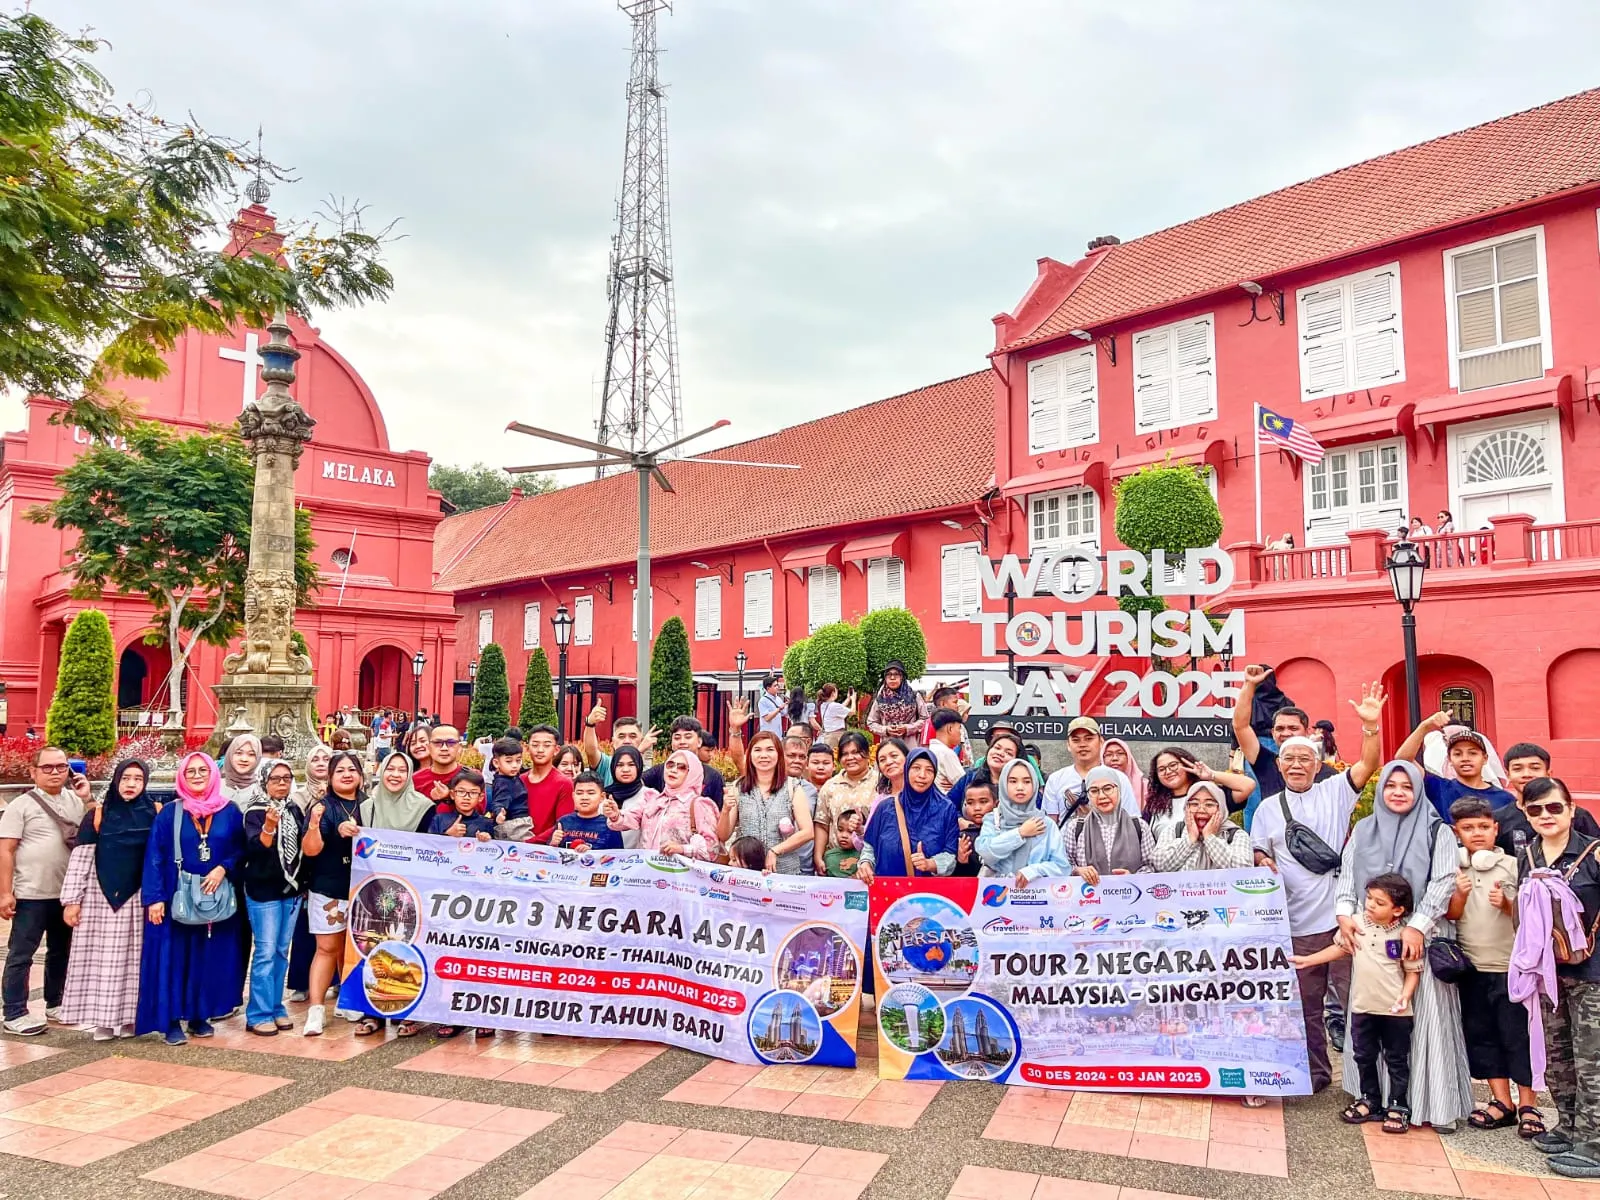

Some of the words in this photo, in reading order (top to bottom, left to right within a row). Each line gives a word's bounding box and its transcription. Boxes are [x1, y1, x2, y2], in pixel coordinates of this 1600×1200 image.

[322, 461, 396, 487] MELAKA
[976, 548, 1234, 603] WORLD
[969, 609, 1246, 657] TOURISM
[969, 670, 1095, 717] DAY
[1104, 670, 1246, 718] 2025
[1010, 722, 1063, 734] OSTED
[1162, 724, 1231, 737] MALAYSI
[418, 855, 450, 866] MALAYSIA
[1181, 889, 1206, 897] Trivat
[1209, 888, 1228, 896] Tour
[1236, 878, 1265, 886] SEGARA
[430, 894, 517, 925] TOUR
[528, 902, 544, 926] 3
[554, 904, 683, 940] NEGARA
[693, 920, 766, 954] ASIA
[426, 932, 500, 950] MALAYSIA
[515, 940, 607, 960] SINGAPORE
[622, 948, 692, 969] THAILAND
[695, 960, 763, 985] (HATYAI)
[990, 952, 1067, 976] TOUR
[1074, 953, 1089, 975] 2
[1097, 949, 1216, 975] NEGARA
[1222, 947, 1290, 971] ASIA
[443, 962, 461, 975] 30
[467, 964, 552, 983] DESEMBER
[558, 973, 597, 987] 2024
[611, 977, 631, 989] 05
[636, 978, 699, 999] JANUARI
[703, 991, 737, 1009] 2025
[1011, 985, 1126, 1005] MALAYSIA
[1149, 980, 1290, 1003] SINGAPORE
[451, 992, 509, 1016] EDISI
[514, 998, 583, 1022] LIBUR
[589, 1005, 668, 1028] TAHUN
[672, 1013, 725, 1043] BARU
[1027, 1068, 1041, 1078] 30
[1046, 1070, 1071, 1080] DES
[1075, 1071, 1106, 1081] 2024
[1118, 1072, 1134, 1081] 03
[1138, 1072, 1165, 1082] JAN
[1169, 1072, 1202, 1082] 2025
[1255, 1078, 1291, 1089] MALAYSIA
